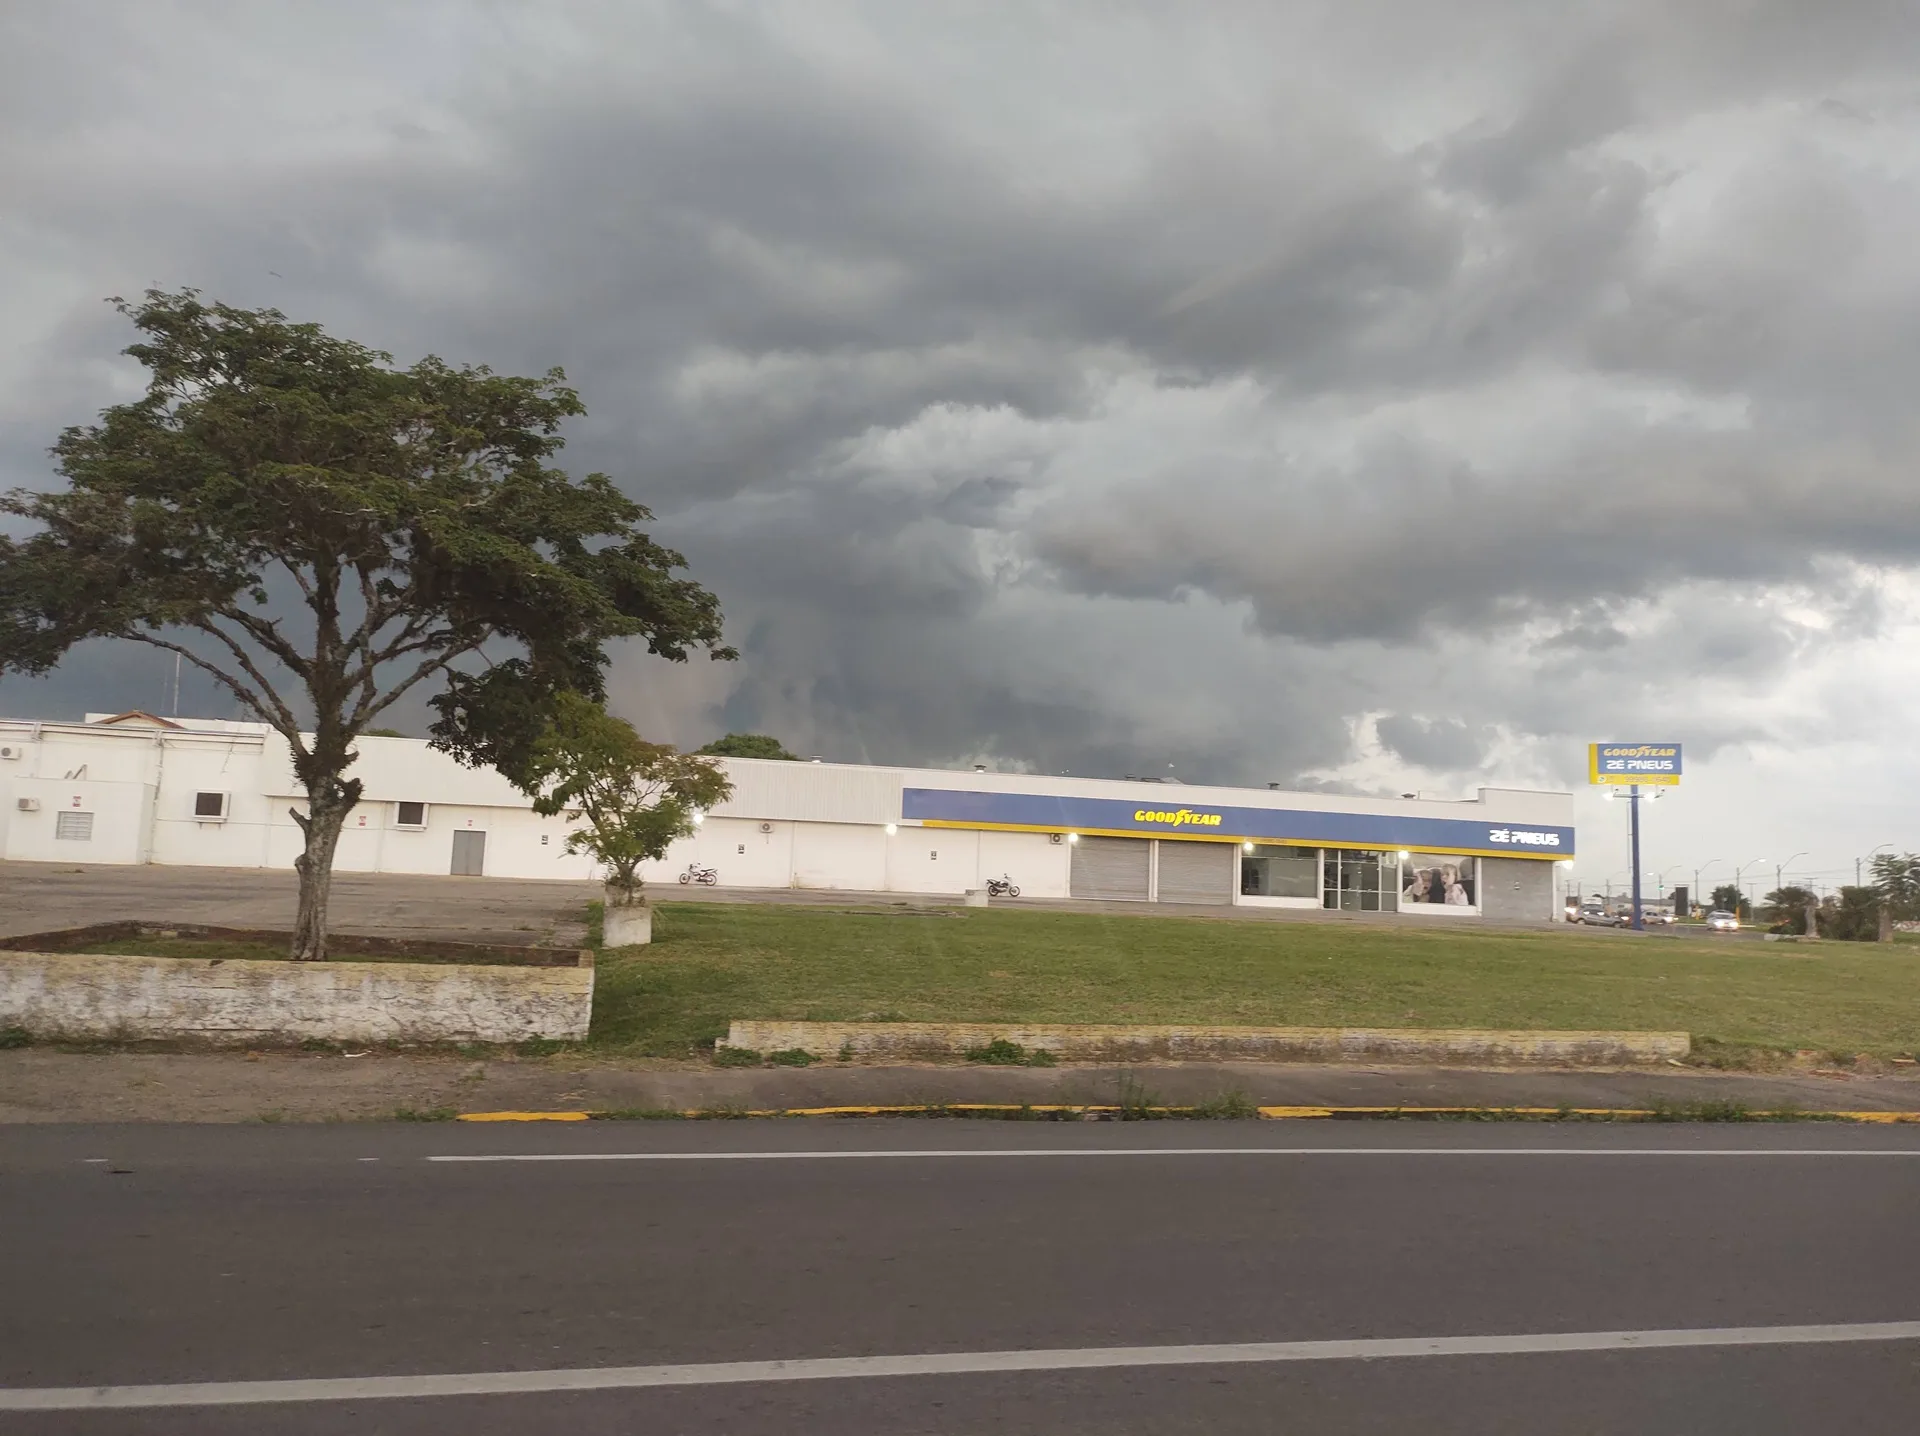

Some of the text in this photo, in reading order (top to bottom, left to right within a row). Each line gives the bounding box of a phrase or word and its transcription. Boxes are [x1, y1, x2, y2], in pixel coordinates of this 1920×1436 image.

[1603, 745, 1676, 758] GOODYEAR
[1606, 758, 1674, 770] ZÉ PNEUS
[1134, 809, 1222, 827] GOODYEAR
[1489, 829, 1560, 846] ZÉ PNEUS
